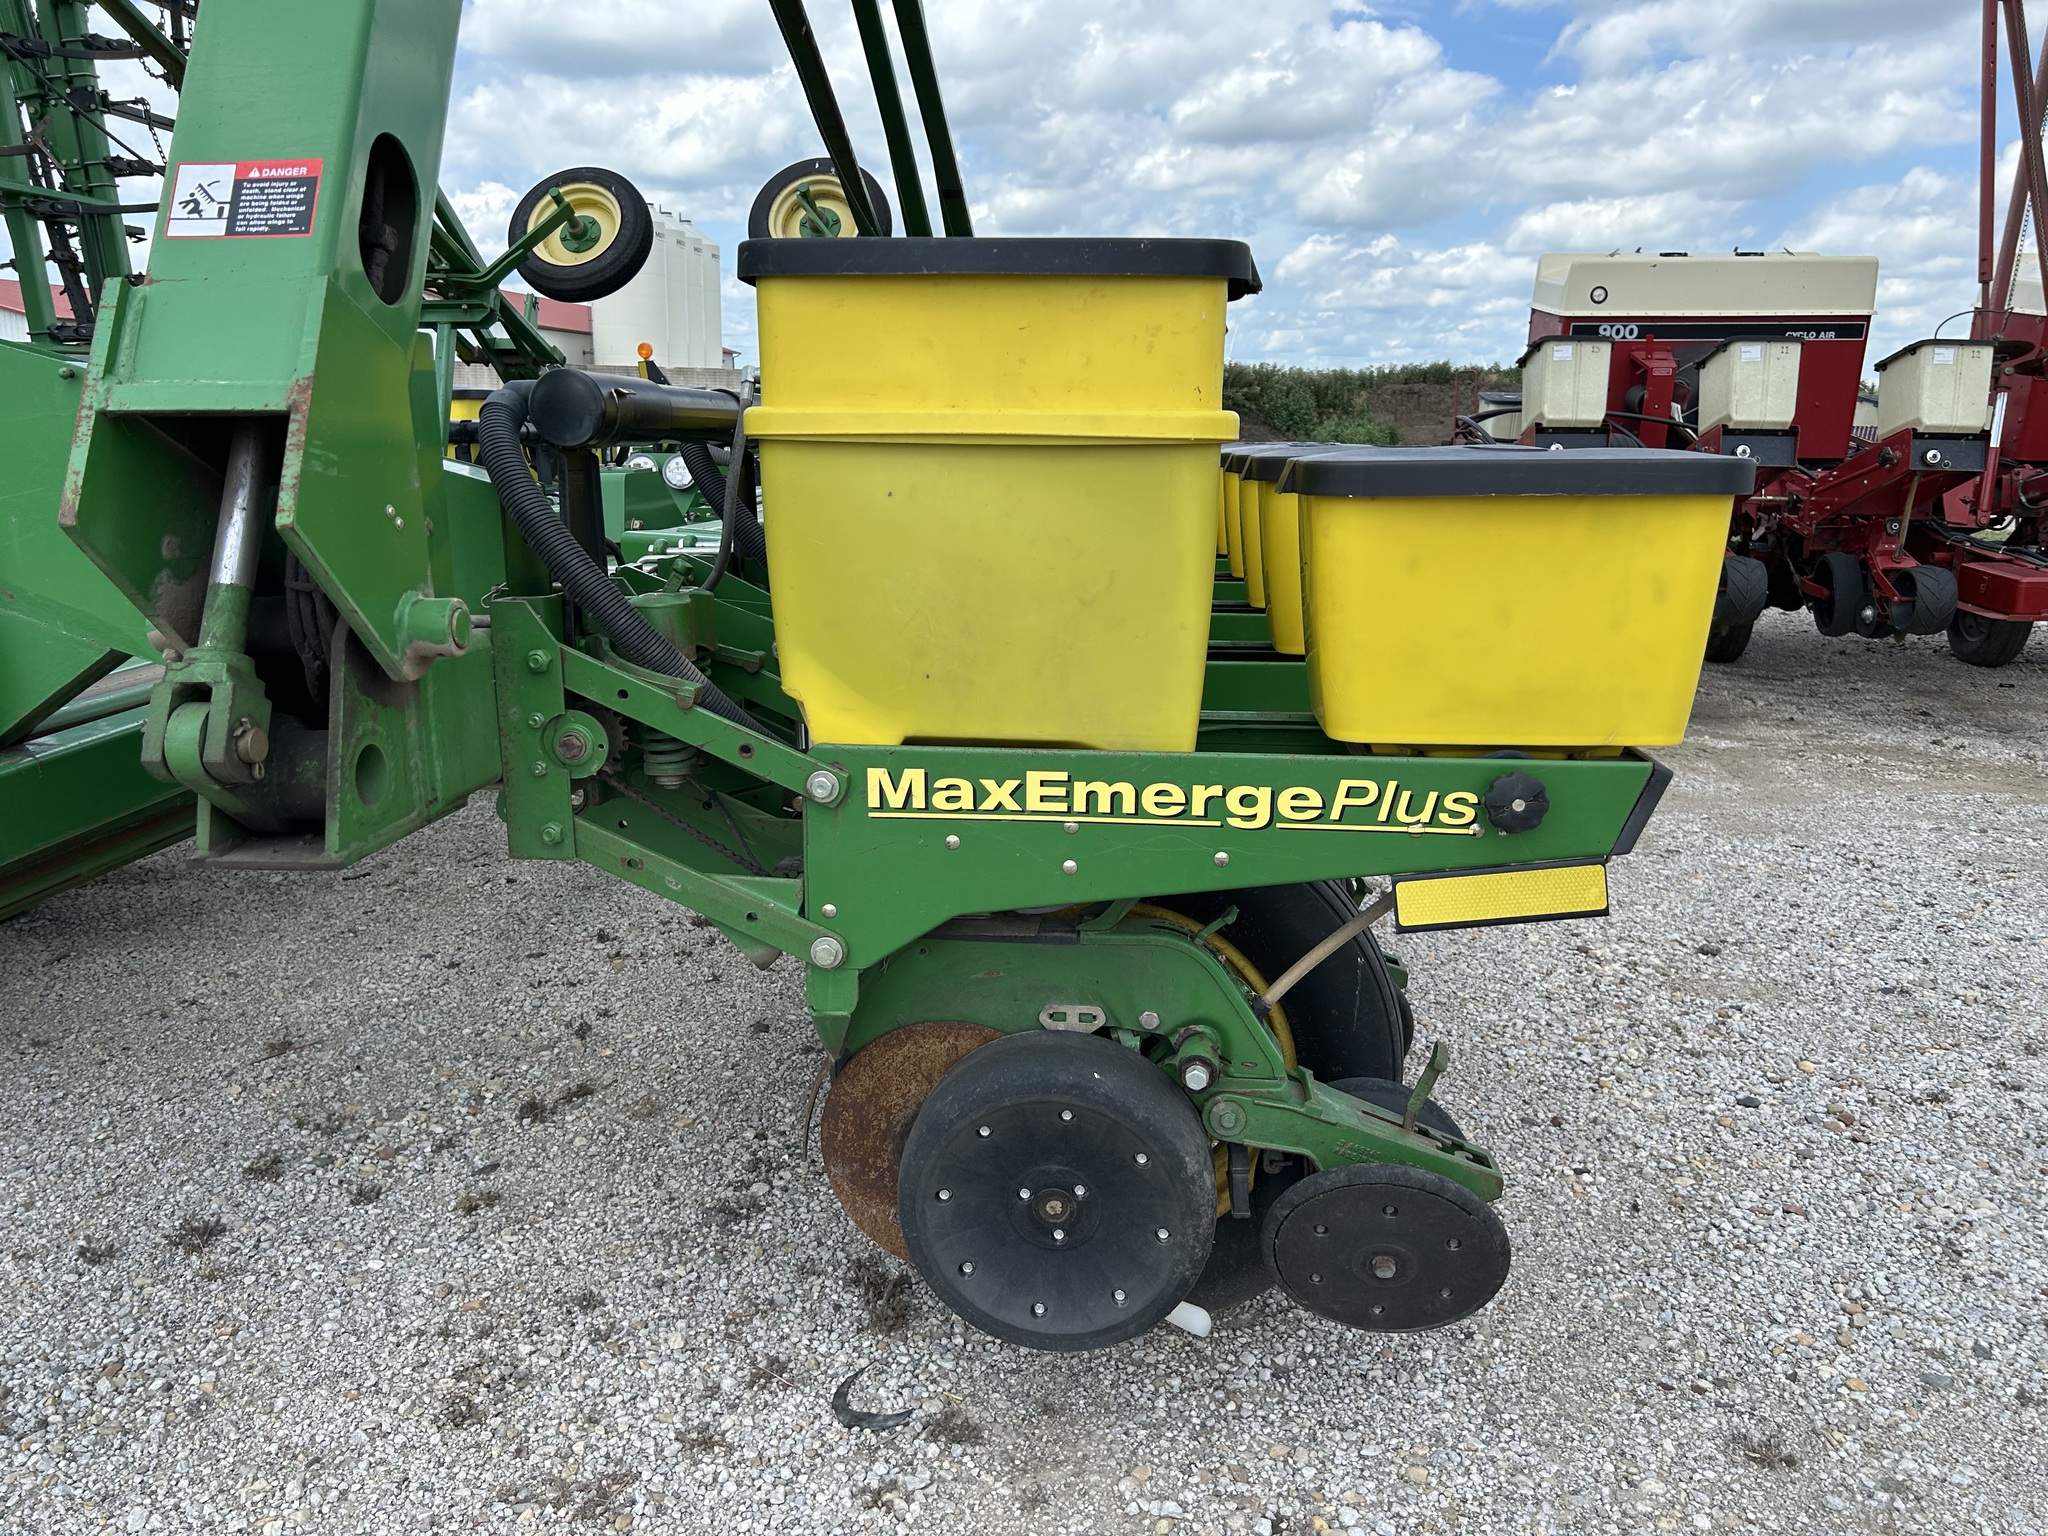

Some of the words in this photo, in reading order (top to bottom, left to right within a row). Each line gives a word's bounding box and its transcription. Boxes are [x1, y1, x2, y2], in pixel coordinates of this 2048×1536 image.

[262, 167, 307, 176] DANGER
[1598, 324, 1639, 339] 900
[1818, 331, 1835, 339] AIR
